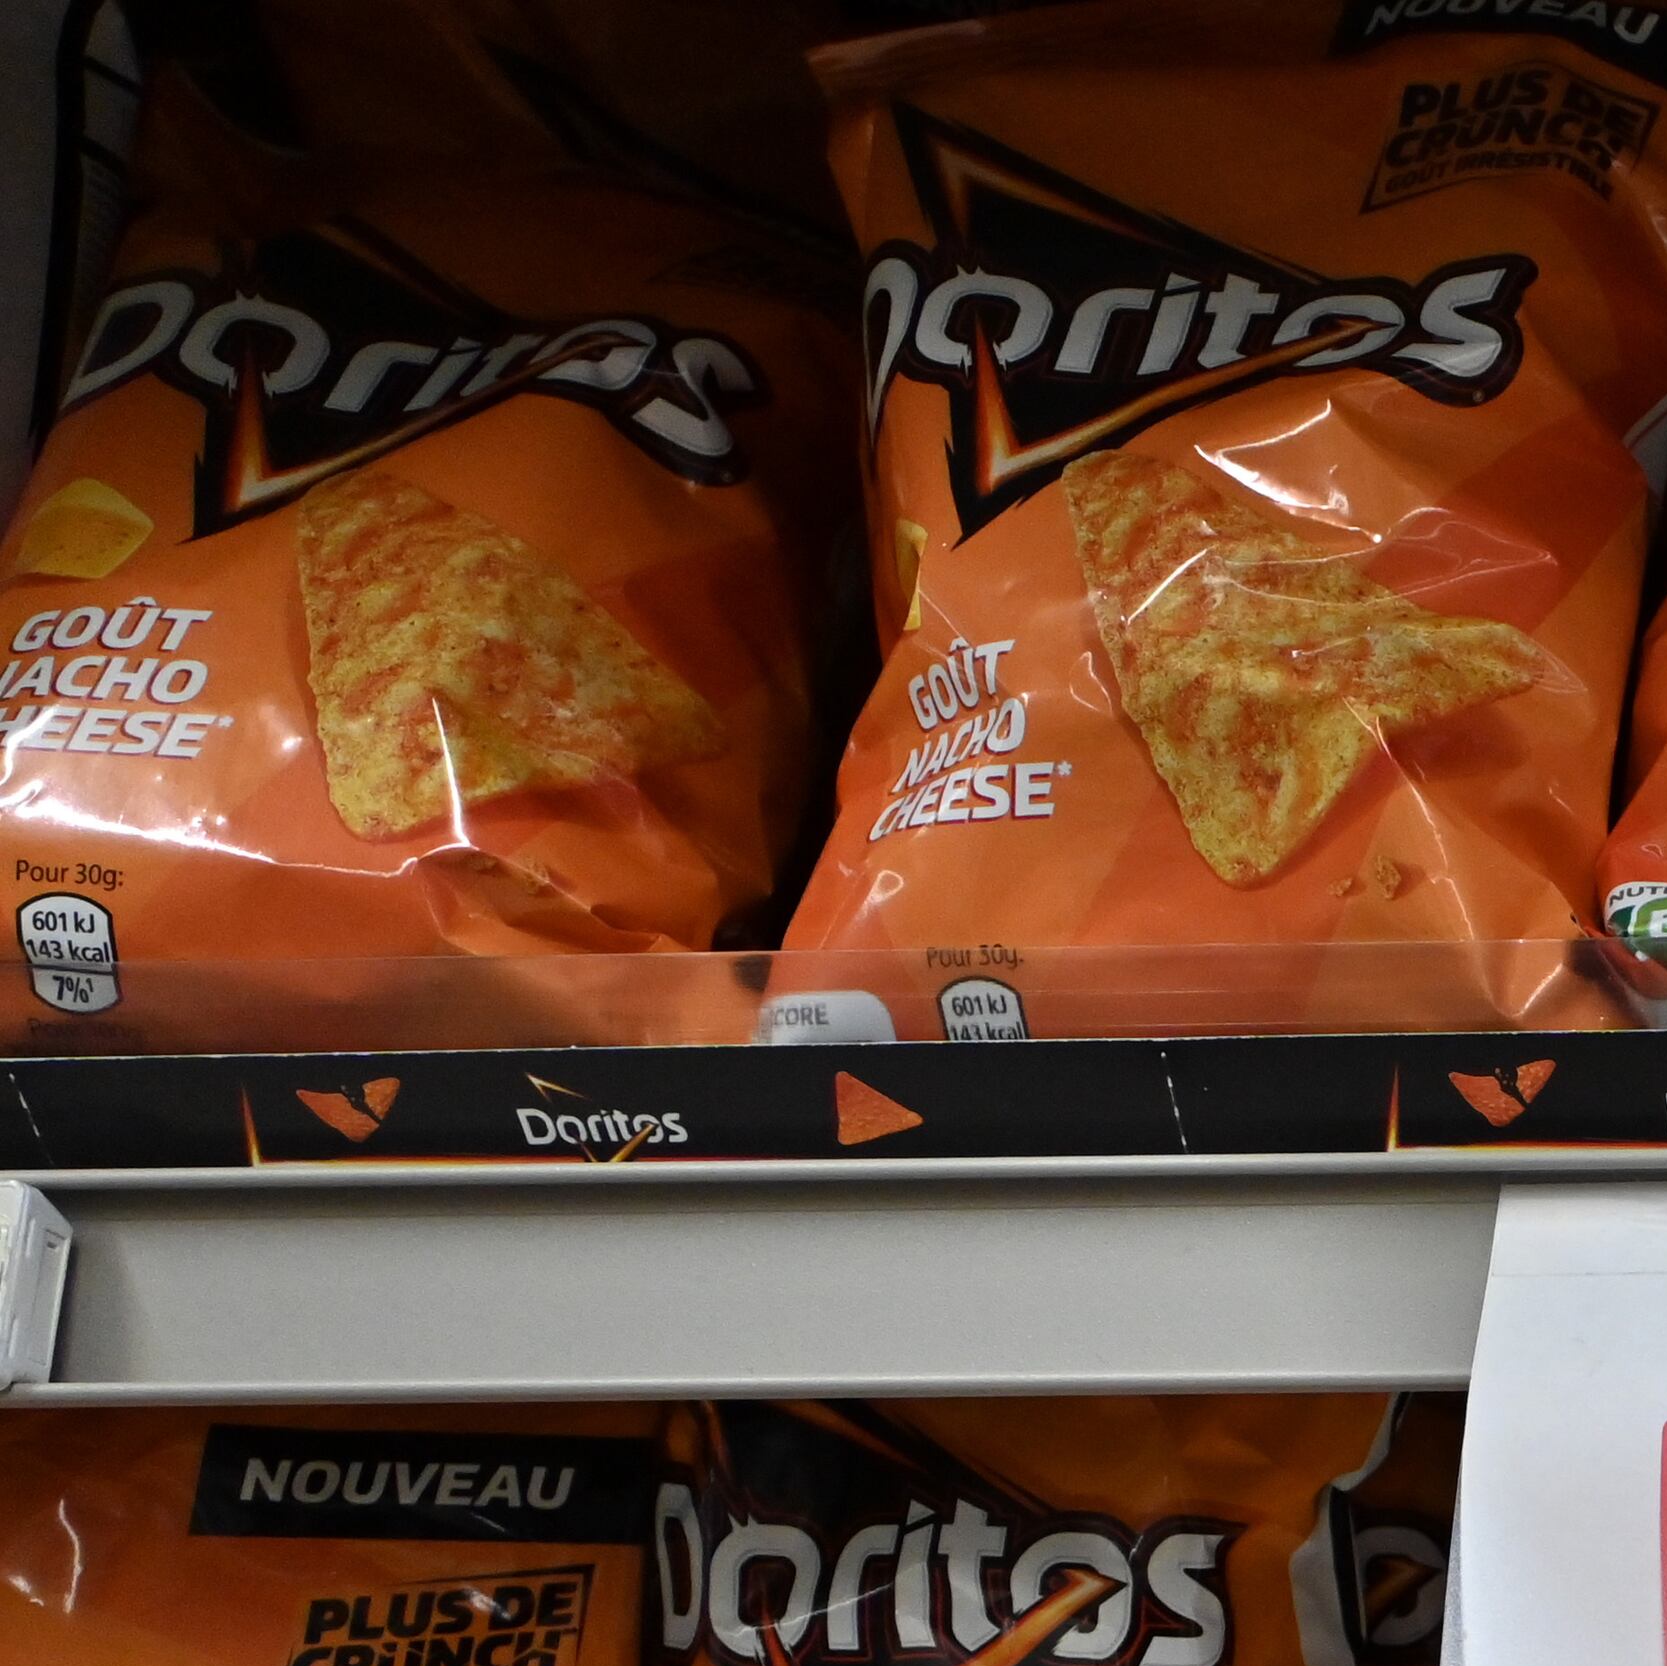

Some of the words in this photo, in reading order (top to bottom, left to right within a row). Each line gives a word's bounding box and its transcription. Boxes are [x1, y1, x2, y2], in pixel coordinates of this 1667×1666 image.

[1402, 69, 1551, 127] PLUS
[13, 596, 212, 653] GOÛT
[908, 637, 1015, 730] GOÛT
[889, 697, 1026, 793] NACHO
[16, 860, 70, 883] Pour
[75, 861, 125, 890] 30g:
[32, 910, 67, 934] 601
[70, 911, 96, 936] kJ
[25, 938, 65, 962] 143
[68, 939, 112, 964] kcal
[951, 994, 985, 1017] 601
[988, 993, 1008, 1016] kJ
[517, 1107, 689, 1148] Doritos
[239, 1457, 575, 1508] NOUVEAU
[303, 1586, 482, 1645] PLUS
[487, 1579, 579, 1630] DE
